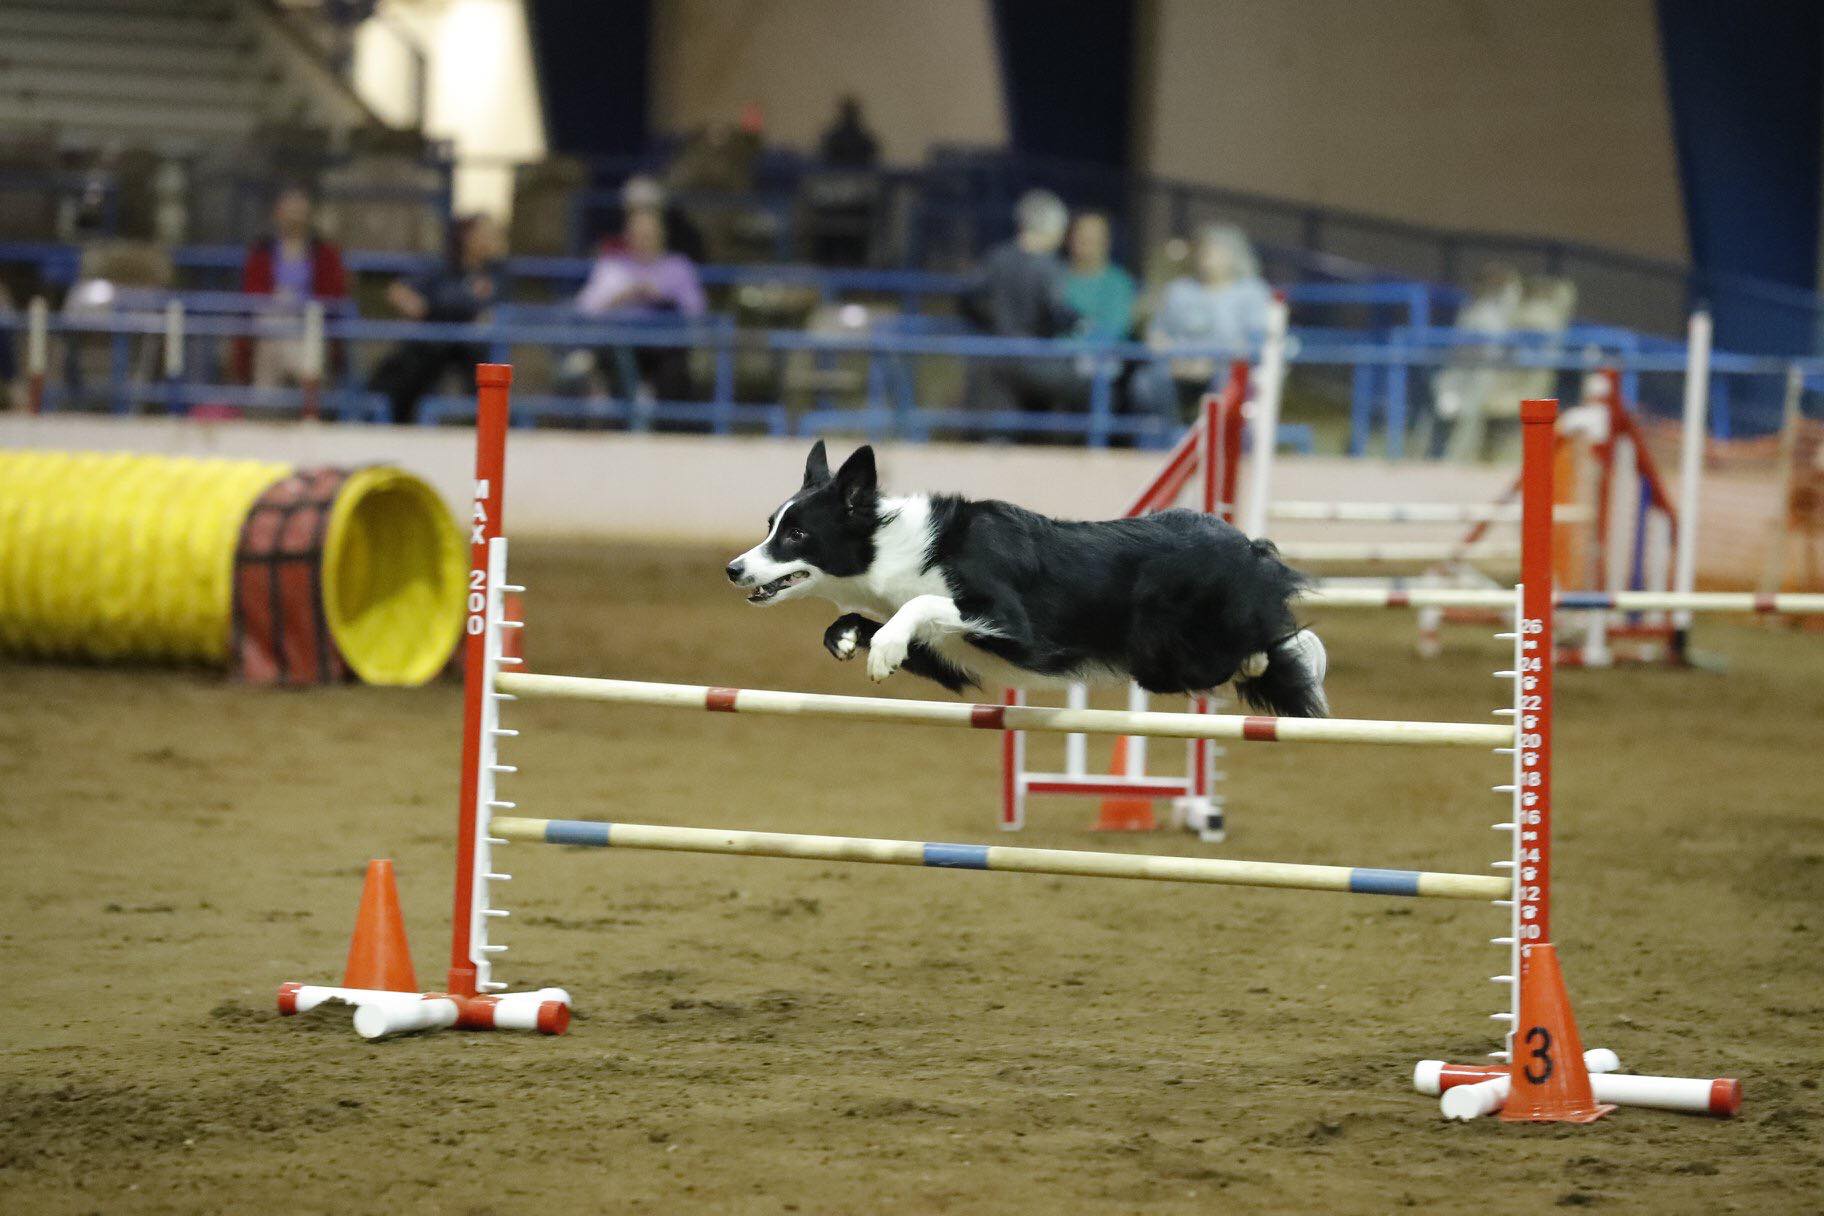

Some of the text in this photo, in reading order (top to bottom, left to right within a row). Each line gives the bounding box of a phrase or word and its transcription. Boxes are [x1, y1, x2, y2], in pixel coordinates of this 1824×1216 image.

[466, 479, 490, 635] MAX 200
[1520, 618, 1543, 634] 26
[1520, 656, 1543, 672] 24
[1520, 695, 1542, 711] 22
[1520, 733, 1542, 748] 20
[1520, 771, 1541, 787] 18
[1519, 809, 1541, 825] 16
[1519, 847, 1541, 863] 14
[1518, 885, 1541, 901] 12
[1518, 924, 1541, 940] 10
[1524, 1026, 1553, 1085] 3
